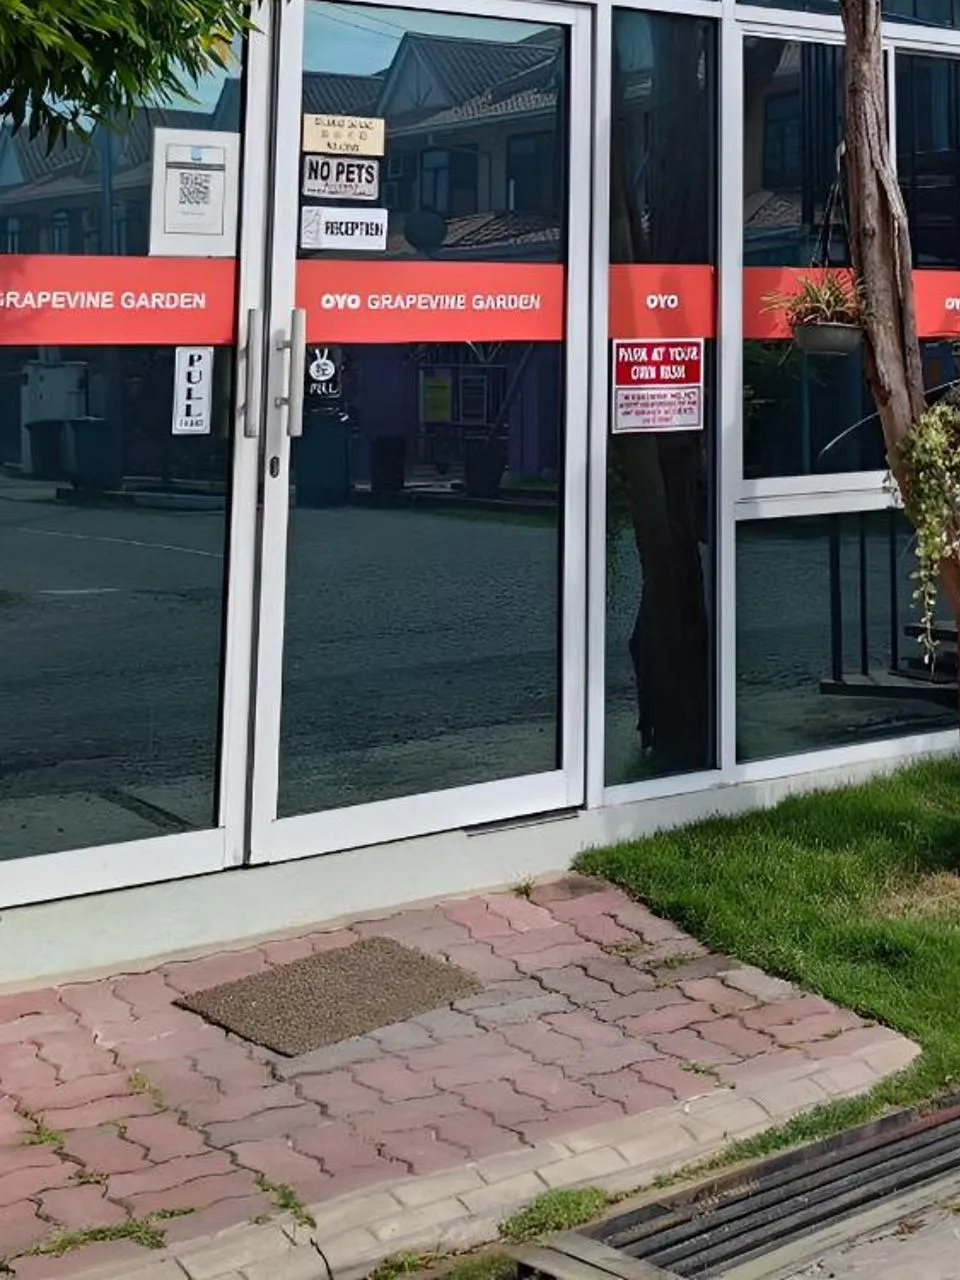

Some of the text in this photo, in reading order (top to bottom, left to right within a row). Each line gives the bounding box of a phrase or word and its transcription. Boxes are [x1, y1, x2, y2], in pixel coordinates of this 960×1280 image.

[308, 159, 375, 184] NO PETS
[120, 291, 206, 309] GARDEN
[320, 293, 541, 310] OYO GRAPEVINE GARDEN
[646, 293, 679, 309] OYO
[185, 353, 203, 418] PULL
